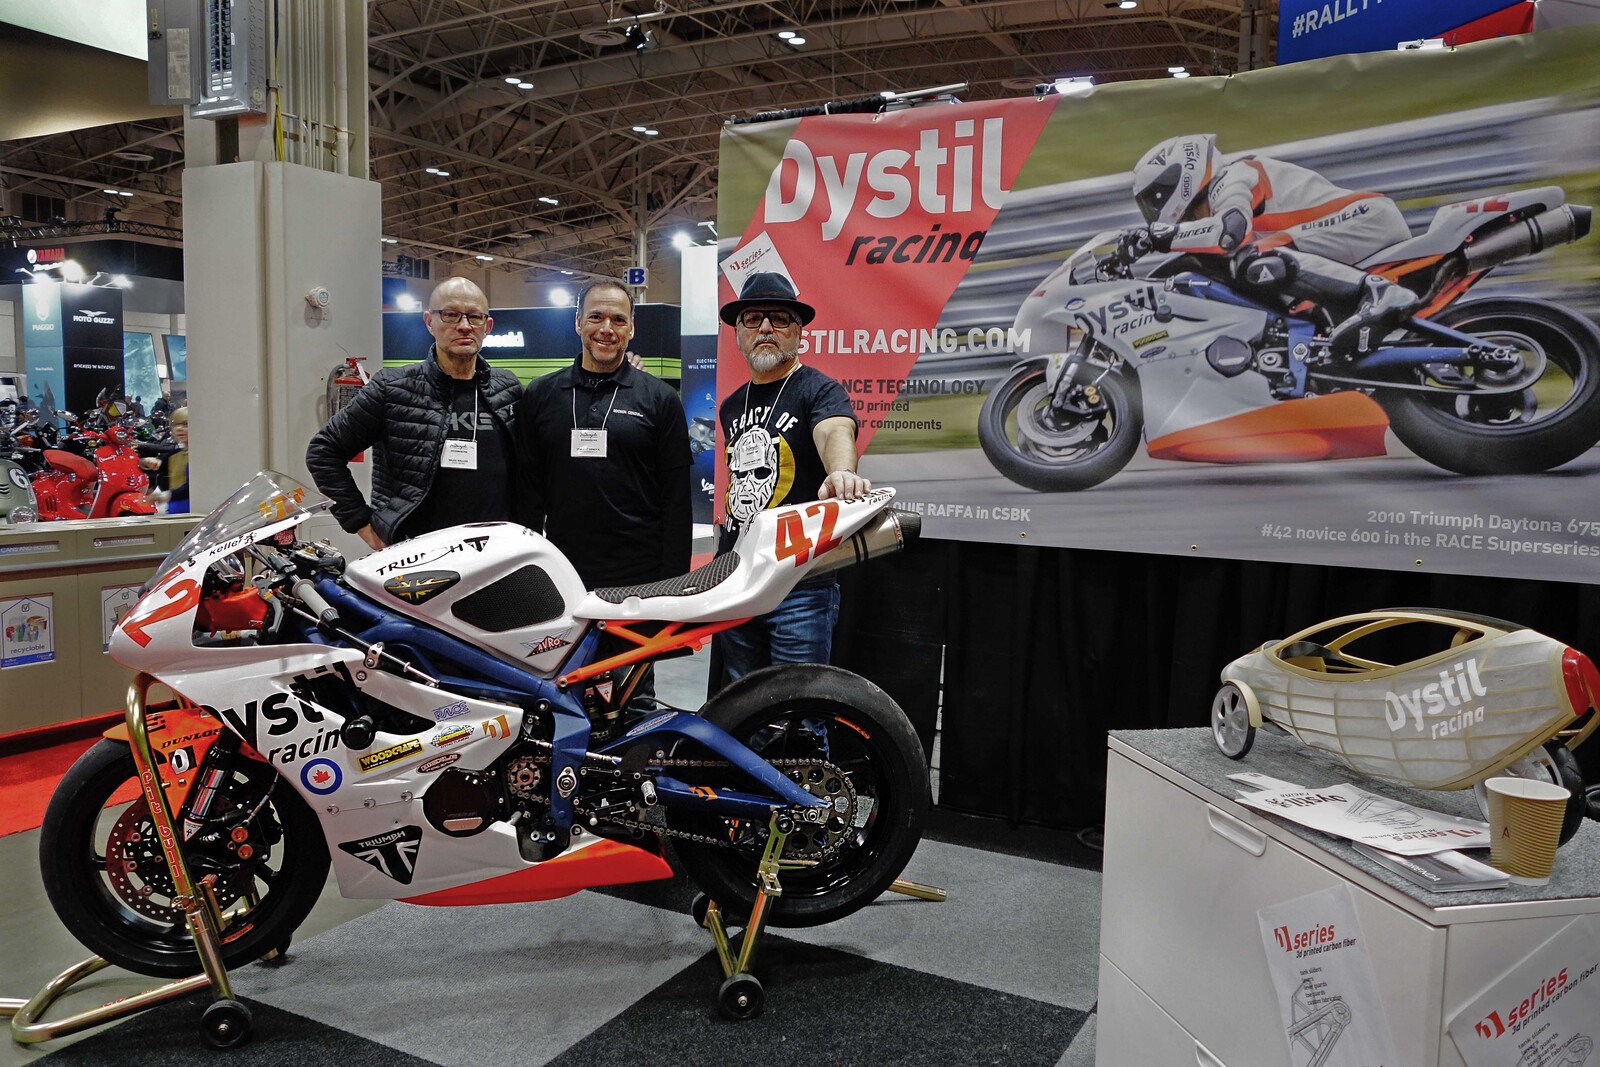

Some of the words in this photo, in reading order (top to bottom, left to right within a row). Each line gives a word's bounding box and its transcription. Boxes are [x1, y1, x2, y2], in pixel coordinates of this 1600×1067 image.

[764, 117, 1011, 241] Dystil
[1175, 224, 1214, 240] AINESE
[36, 247, 65, 262] YAMAHA
[629, 268, 645, 285] B
[32, 323, 55, 331] PIAGGIO
[73, 315, 92, 323] MOTO
[93, 316, 115, 325] GUZZI
[1112, 313, 1154, 340] racin
[797, 327, 1032, 354] STILRACING.COM
[840, 379, 873, 394] NCE
[876, 379, 986, 395] TECHNOLOGY
[850, 401, 864, 411] 3D
[867, 400, 910, 413] printed
[729, 406, 771, 440] LEGACY
[775, 412, 798, 432] OF
[856, 420, 867, 429] ar
[870, 420, 942, 431] components
[927, 503, 974, 519] RAFFA
[976, 506, 989, 519] in
[992, 507, 1031, 522] CSBK
[1367, 510, 1405, 524] 2010
[1409, 510, 1484, 530] Triumph
[1488, 515, 1562, 534] Daytona
[1567, 519, 1600, 537] 675
[775, 502, 844, 568] 42
[1261, 523, 1292, 539] #42
[1296, 526, 1347, 541] novice
[1350, 528, 1380, 544] 600
[1384, 531, 1399, 545] in
[1403, 531, 1431, 548] the
[1435, 533, 1483, 550] RACE
[1486, 536, 1600, 557] Superseries
[11, 644, 46, 654] recyclable
[538, 636, 561, 651] AVRO
[1385, 658, 1487, 732] Dystil
[269, 728, 341, 765] racin
[360, 739, 420, 766] WOODCRAFT
[358, 830, 406, 848] TRIUMPH
[1392, 831, 1447, 843] series
[1293, 923, 1336, 950] series
[1296, 950, 1302, 958] 3d
[1303, 946, 1322, 959] printed
[1323, 942, 1342, 952] carbon
[1343, 938, 1356, 948] fiber
[1506, 967, 1568, 1028] series
[1511, 1024, 1521, 1036] 3d
[1523, 999, 1550, 1029] printed
[1551, 978, 1578, 1003] carbon
[1579, 962, 1599, 982] fiber
[1518, 1038, 1531, 1049] tank
[1532, 1022, 1550, 1039] sliders
[1540, 1032, 1559, 1049] guards
[1550, 1033, 1581, 1058] fabrication
